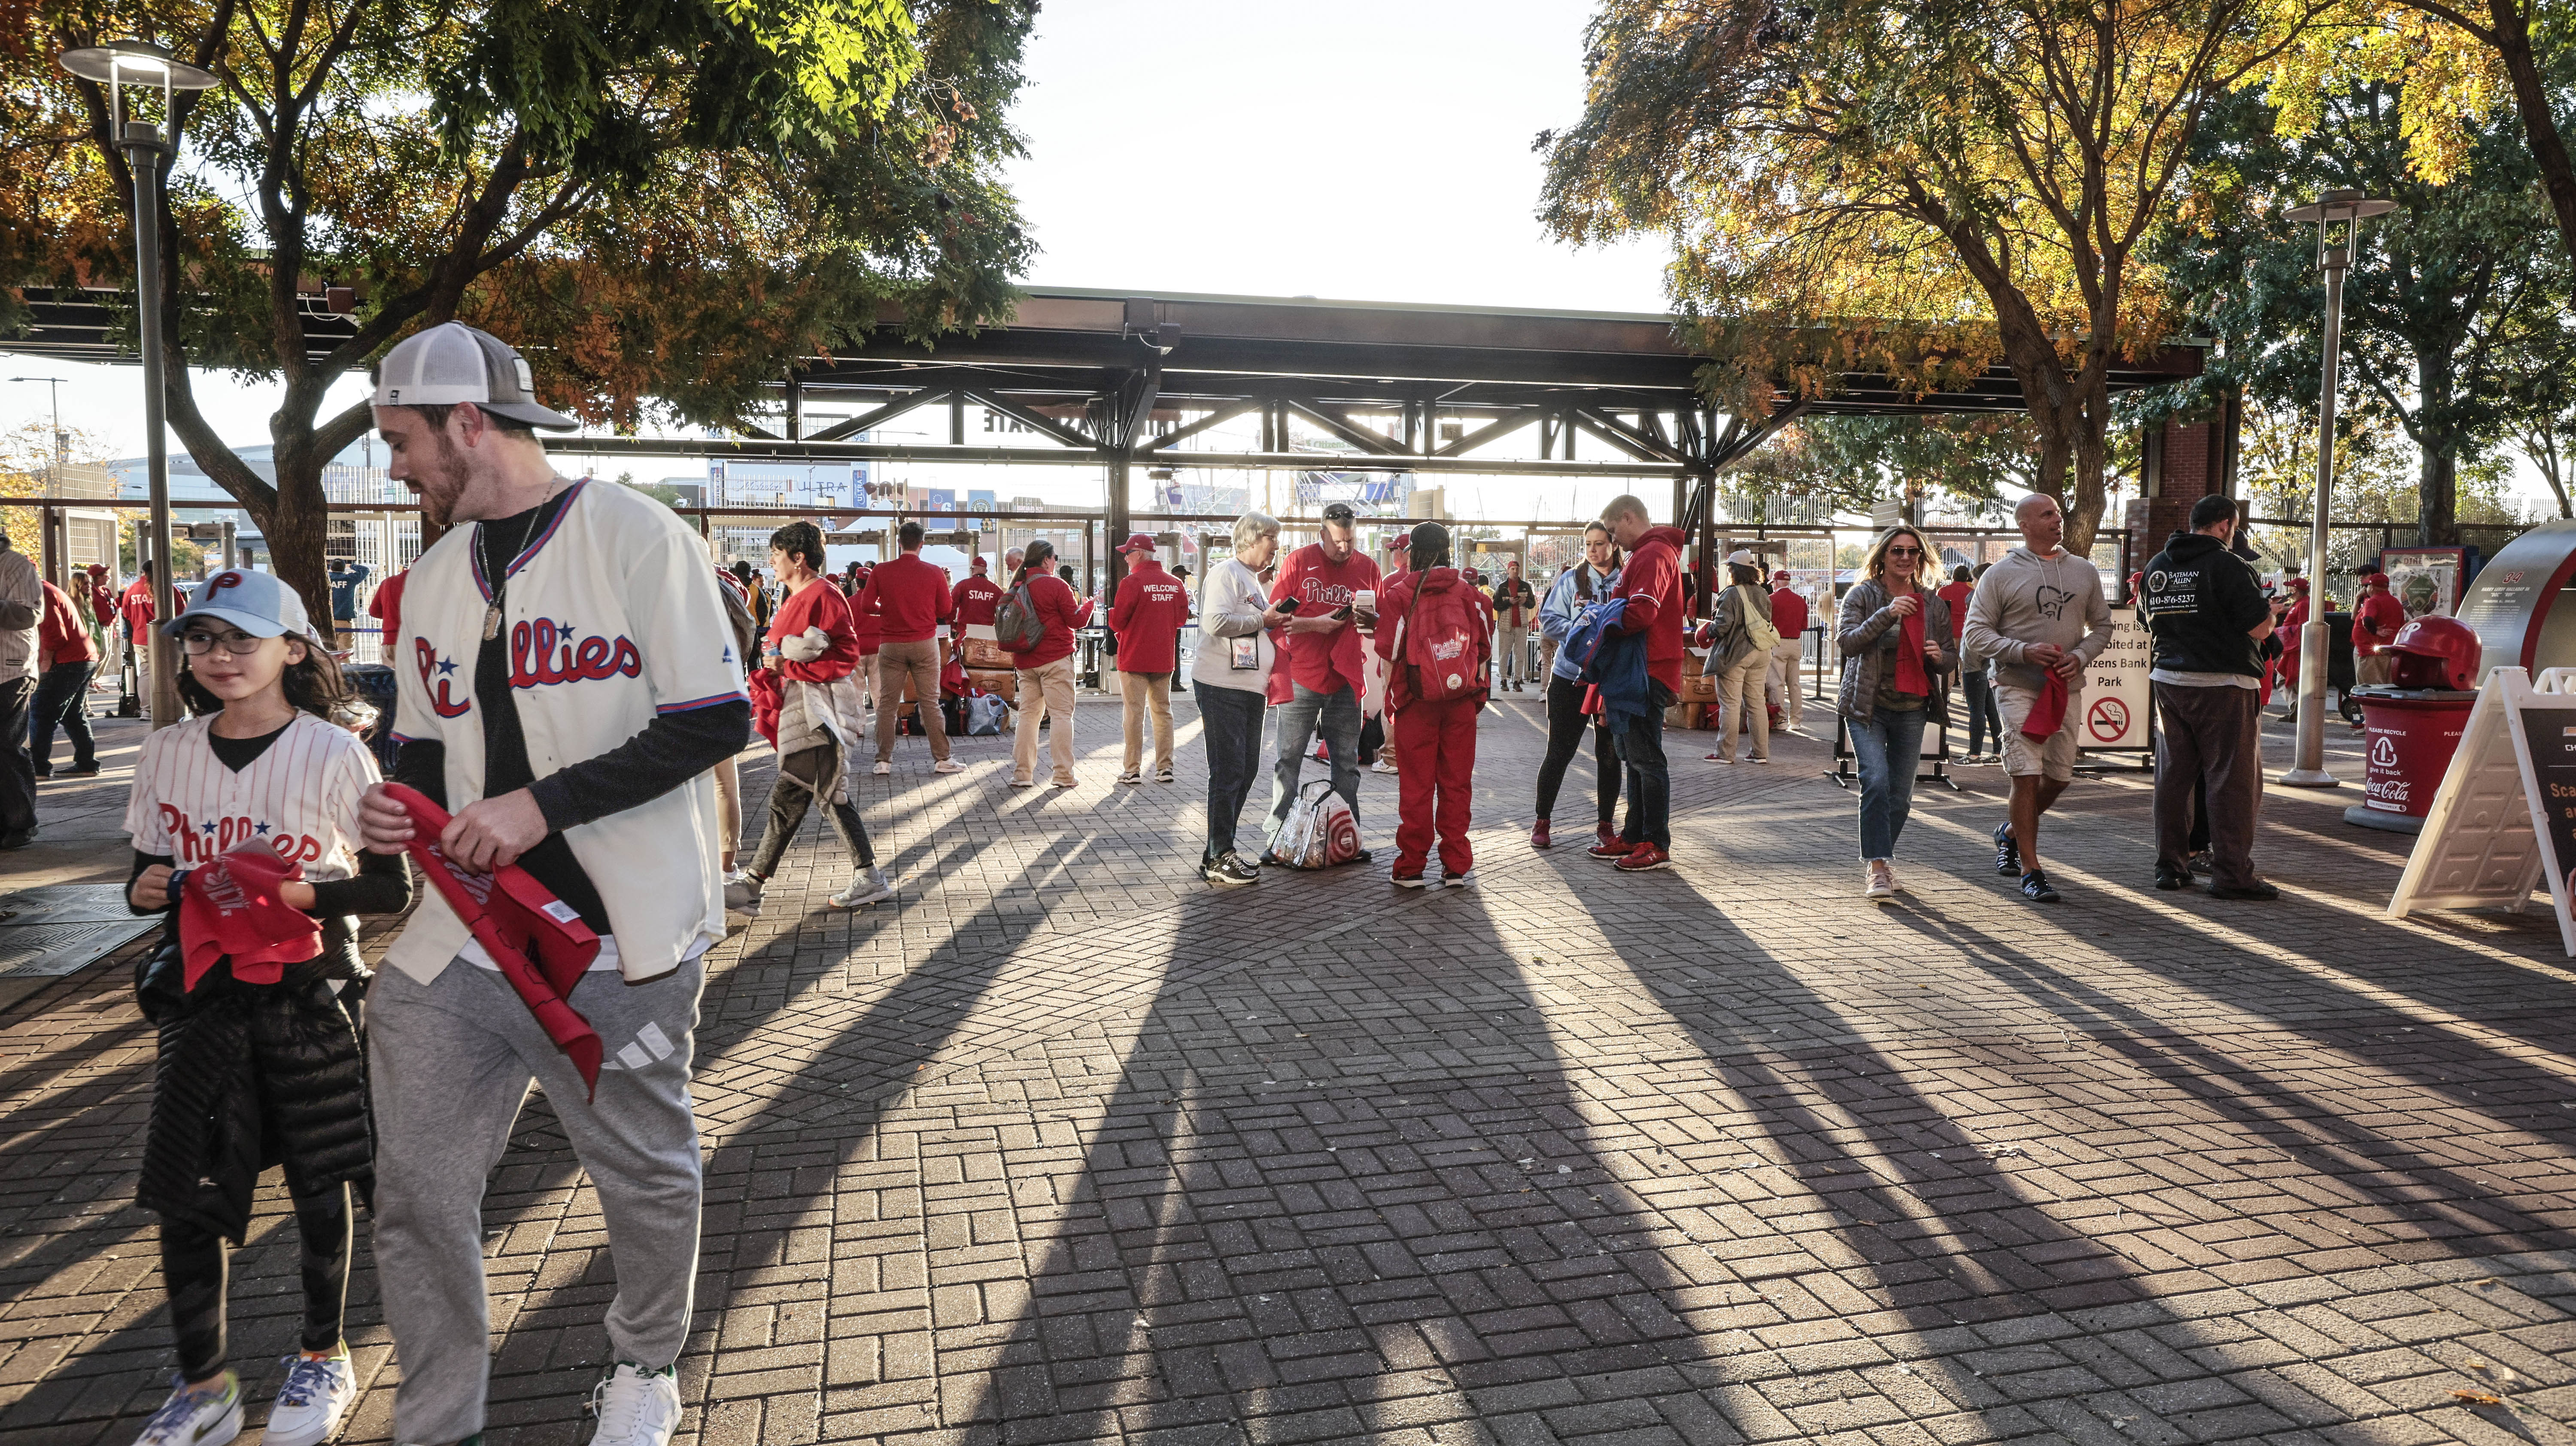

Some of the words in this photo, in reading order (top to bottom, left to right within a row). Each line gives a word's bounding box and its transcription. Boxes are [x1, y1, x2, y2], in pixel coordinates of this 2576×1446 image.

[798, 481, 846, 492] ULTRA
[2502, 571, 2524, 583] 34
[206, 572, 243, 601] P
[1143, 584, 1179, 593] WELCOME
[1302, 577, 1354, 606] Philli
[131, 594, 153, 605] STA
[969, 590, 994, 601] STAFF
[2150, 594, 2195, 605] 610-876-5237
[2403, 622, 2421, 642] P
[2136, 640, 2147, 650] at
[2120, 657, 2147, 668] Bank
[2098, 676, 2122, 687] Park
[2366, 777, 2411, 801] Coca-Cola
[2550, 783, 2576, 798] Sca
[158, 802, 322, 864] Philles
